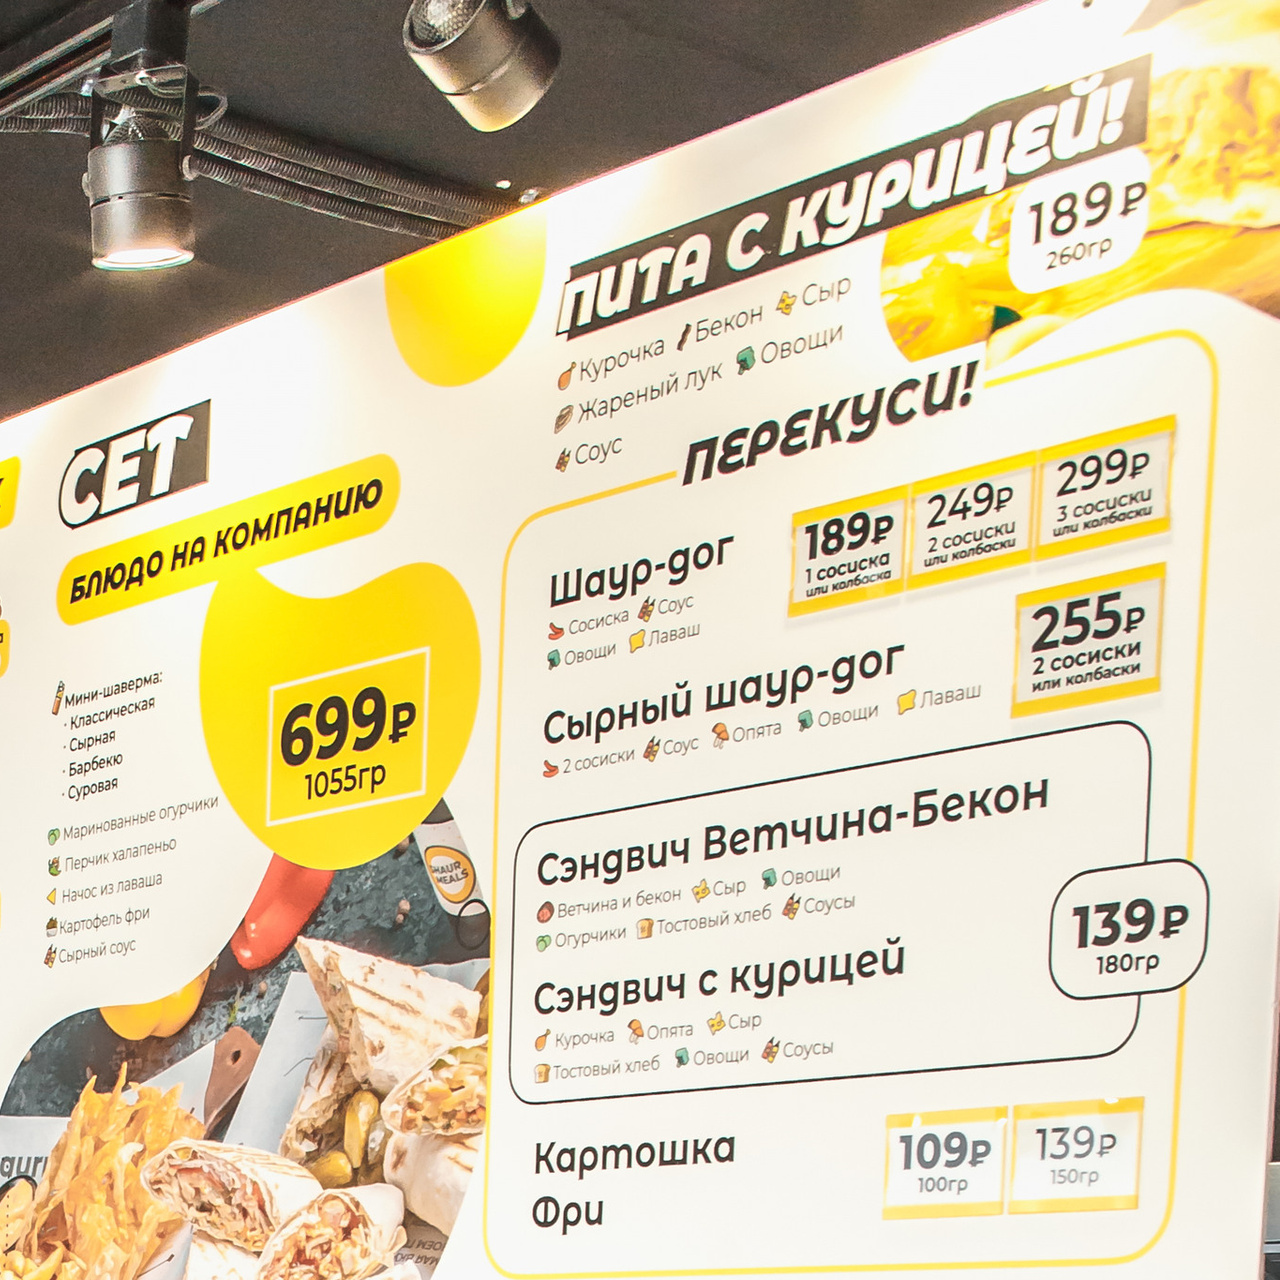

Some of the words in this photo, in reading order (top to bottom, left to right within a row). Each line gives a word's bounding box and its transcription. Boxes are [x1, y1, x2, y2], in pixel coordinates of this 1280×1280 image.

[557, 232, 712, 335] ПИТА
[779, 73, 1135, 256] КУРИЦЕЙ!
[1046, 234, 1112, 271] 260гр
[580, 339, 664, 382] Курочка
[696, 305, 763, 343] Бекон
[802, 277, 851, 306] Сыр
[578, 375, 679, 423] Жареный
[684, 362, 723, 391] лук
[760, 325, 844, 365] Овощи
[682, 360, 980, 486] ПЕРЕКУСИ!
[59, 413, 194, 529] СЕТ
[1073, 489, 1152, 518] сосиски
[70, 550, 163, 605] БЛЮДО
[171, 535, 205, 573] НА
[214, 478, 383, 559] КОМПАНИЮ
[942, 522, 1015, 549] сосиски
[550, 536, 734, 608] Шаур-дог
[817, 552, 890, 582] сосиска
[832, 569, 891, 592] колбаска
[569, 608, 629, 635] Сосиска
[657, 594, 694, 614] Соус
[648, 623, 701, 647] Лаваш
[1051, 641, 1141, 672] сосиски
[1066, 662, 1141, 686] колбаски
[64, 671, 162, 708] Мини-шаверма:
[543, 681, 692, 744] Сырный
[705, 644, 905, 712] шаур-дог
[818, 703, 879, 727] Овощи
[920, 684, 981, 708] Лаваш
[70, 696, 155, 730] Классическая
[69, 729, 116, 752] Сырная
[68, 752, 123, 777] Барбекю
[305, 763, 386, 800] 1055гр
[68, 778, 118, 802] Суровая
[63, 809, 156, 841] Маринованные
[158, 795, 219, 822] огурчики
[537, 836, 690, 885] Сэндвич
[704, 779, 1049, 860] Ветчина-Бекон
[64, 850, 110, 872] Перчик
[112, 836, 177, 862] халапеньо
[62, 882, 98, 904] Начос
[117, 871, 162, 893] лаваша
[558, 899, 618, 919] Ветчина
[635, 887, 681, 907] бекон
[781, 865, 841, 888] Овощи
[555, 926, 626, 950] Огурчики
[658, 909, 730, 935] Тостовый
[734, 904, 771, 926] хлеб
[804, 894, 855, 915] Соусы
[535, 972, 685, 1017] Сэндвич
[698, 969, 718, 996] с
[730, 938, 905, 999] курицей
[1096, 951, 1160, 977] 180гр
[534, 1134, 736, 1181] Картошка
[918, 1175, 968, 1195] 100гр
[1050, 1168, 1099, 1187] 150гр
[531, 1196, 603, 1235] Фри
